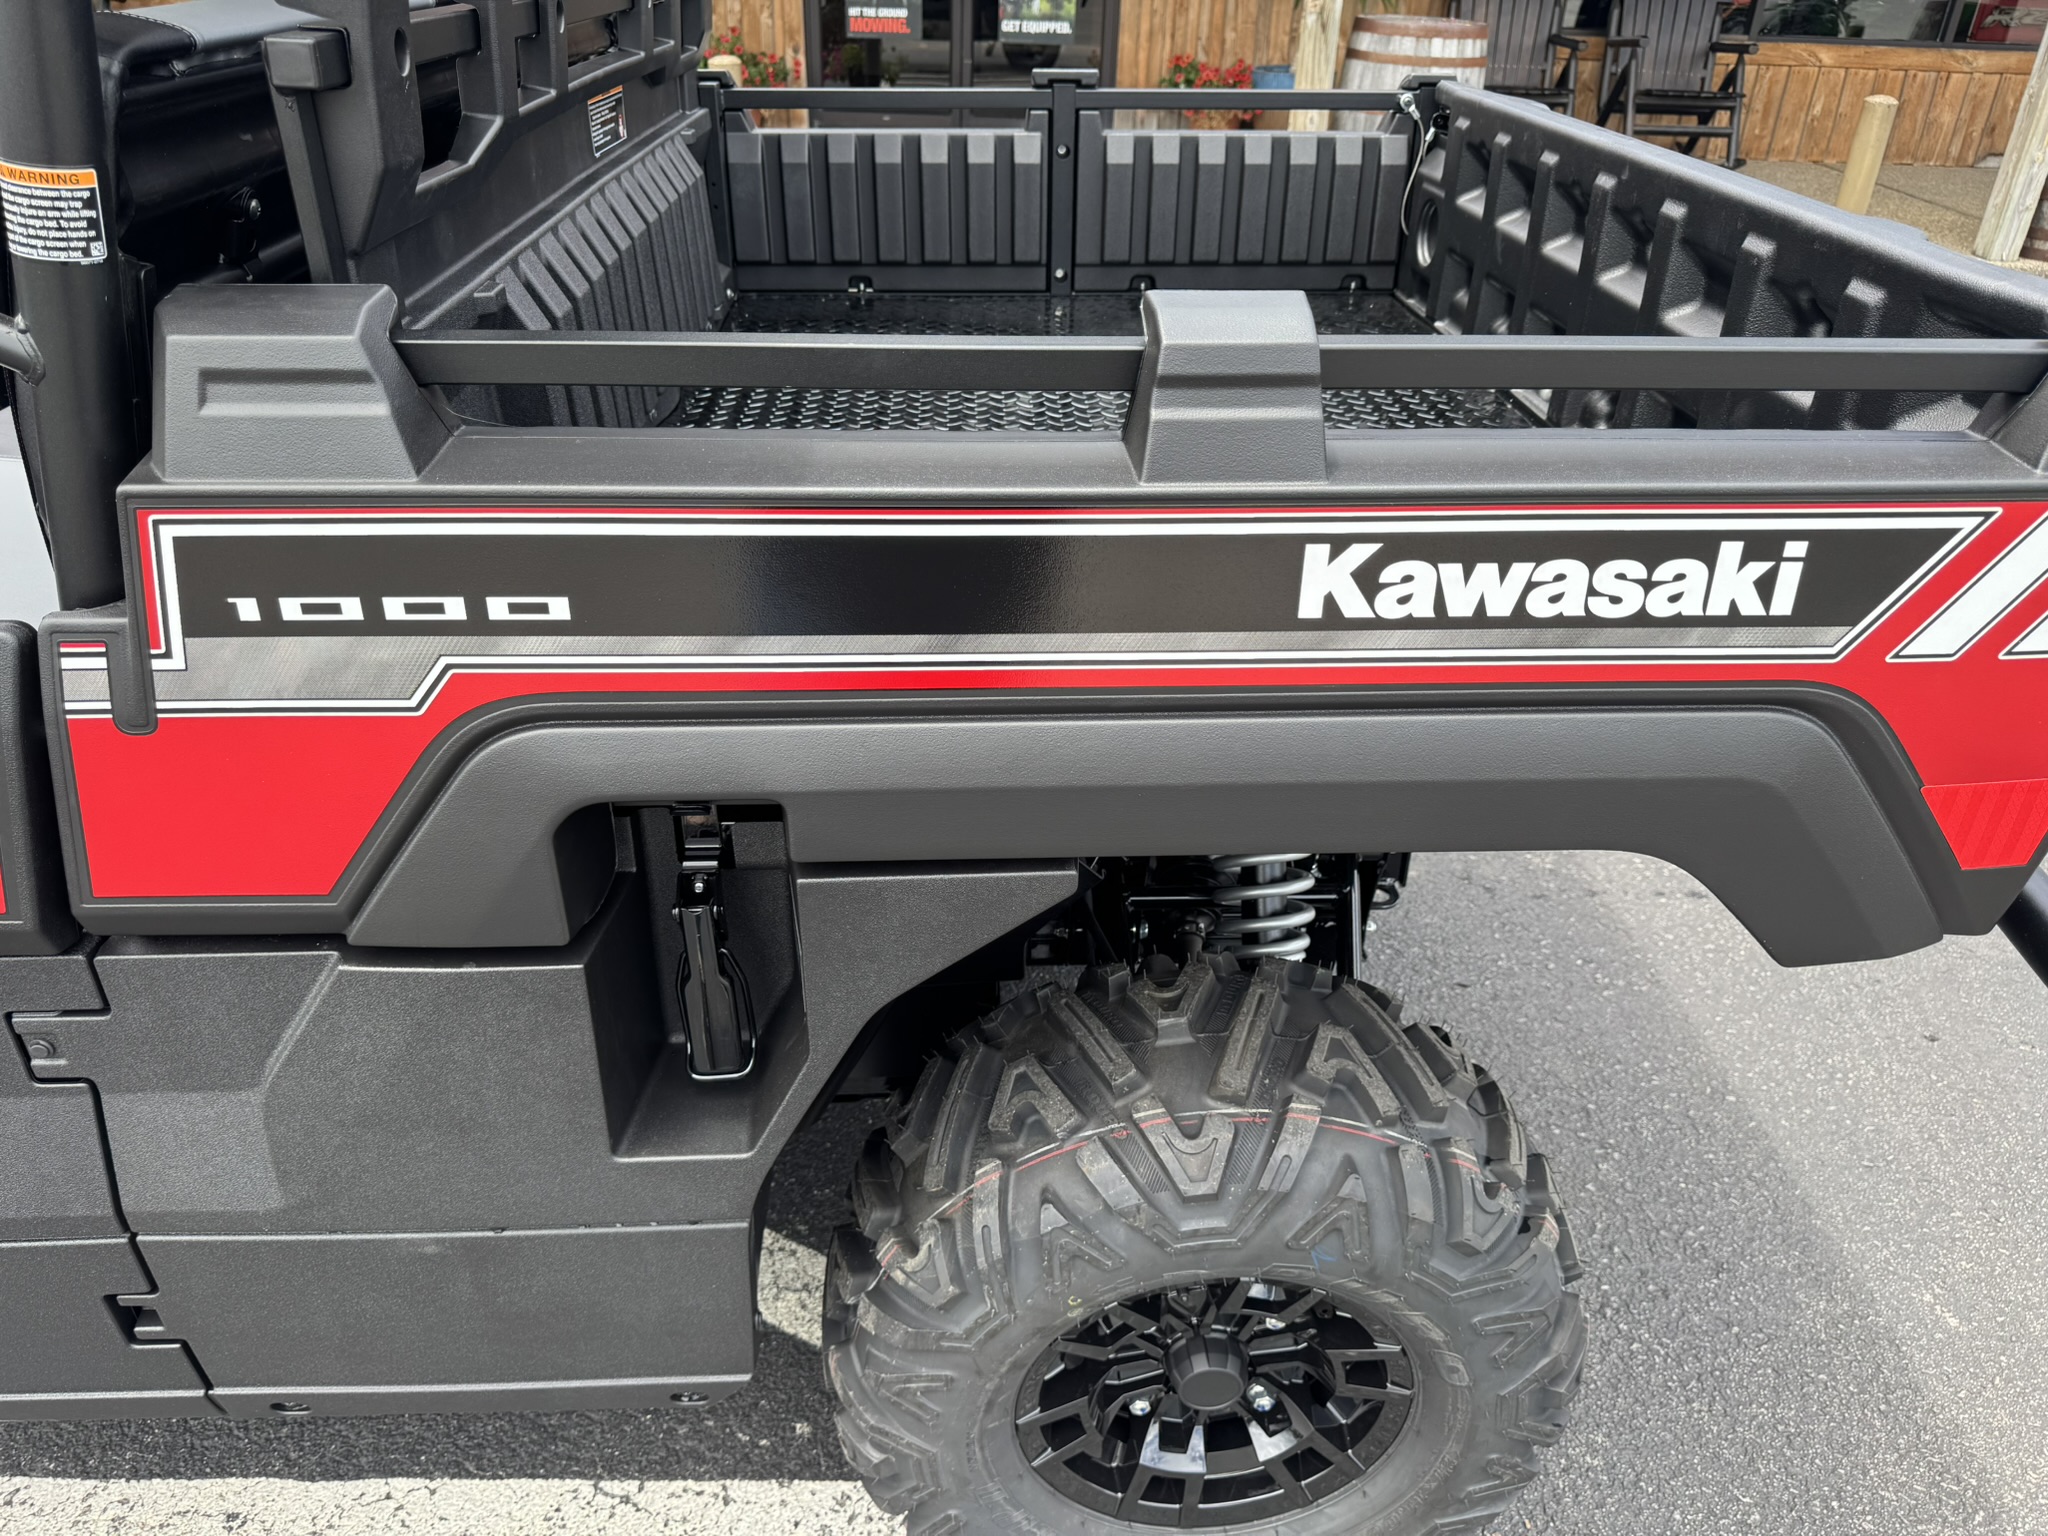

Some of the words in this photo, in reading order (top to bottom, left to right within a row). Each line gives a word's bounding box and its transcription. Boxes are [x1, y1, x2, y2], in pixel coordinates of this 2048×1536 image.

[861, 7, 877, 17] THE
[877, 7, 908, 18] GROUND
[849, 17, 911, 34] MOWING.
[1001, 19, 1020, 33] GET
[1021, 20, 1072, 34] EQUIPPED.
[7, 167, 80, 185] WARNING
[32, 188, 60, 198] between
[61, 190, 72, 198] the
[73, 191, 91, 199] cargo
[31, 198, 53, 207] screen
[54, 201, 68, 209] may
[69, 200, 82, 209] trap
[61, 210, 79, 218] while
[26, 217, 43, 228] cargo
[60, 219, 68, 228] To
[70, 219, 88, 228] avoid
[48, 229, 67, 239] place
[68, 230, 87, 238] hands
[88, 230, 96, 238] on
[28, 237, 45, 247] cargo
[46, 239, 68, 248] screen
[69, 240, 86, 248] when
[38, 248, 48, 257] the
[49, 248, 68, 259] cargo
[1297, 540, 1809, 619] Kawasaki
[227, 596, 572, 622] 1000
